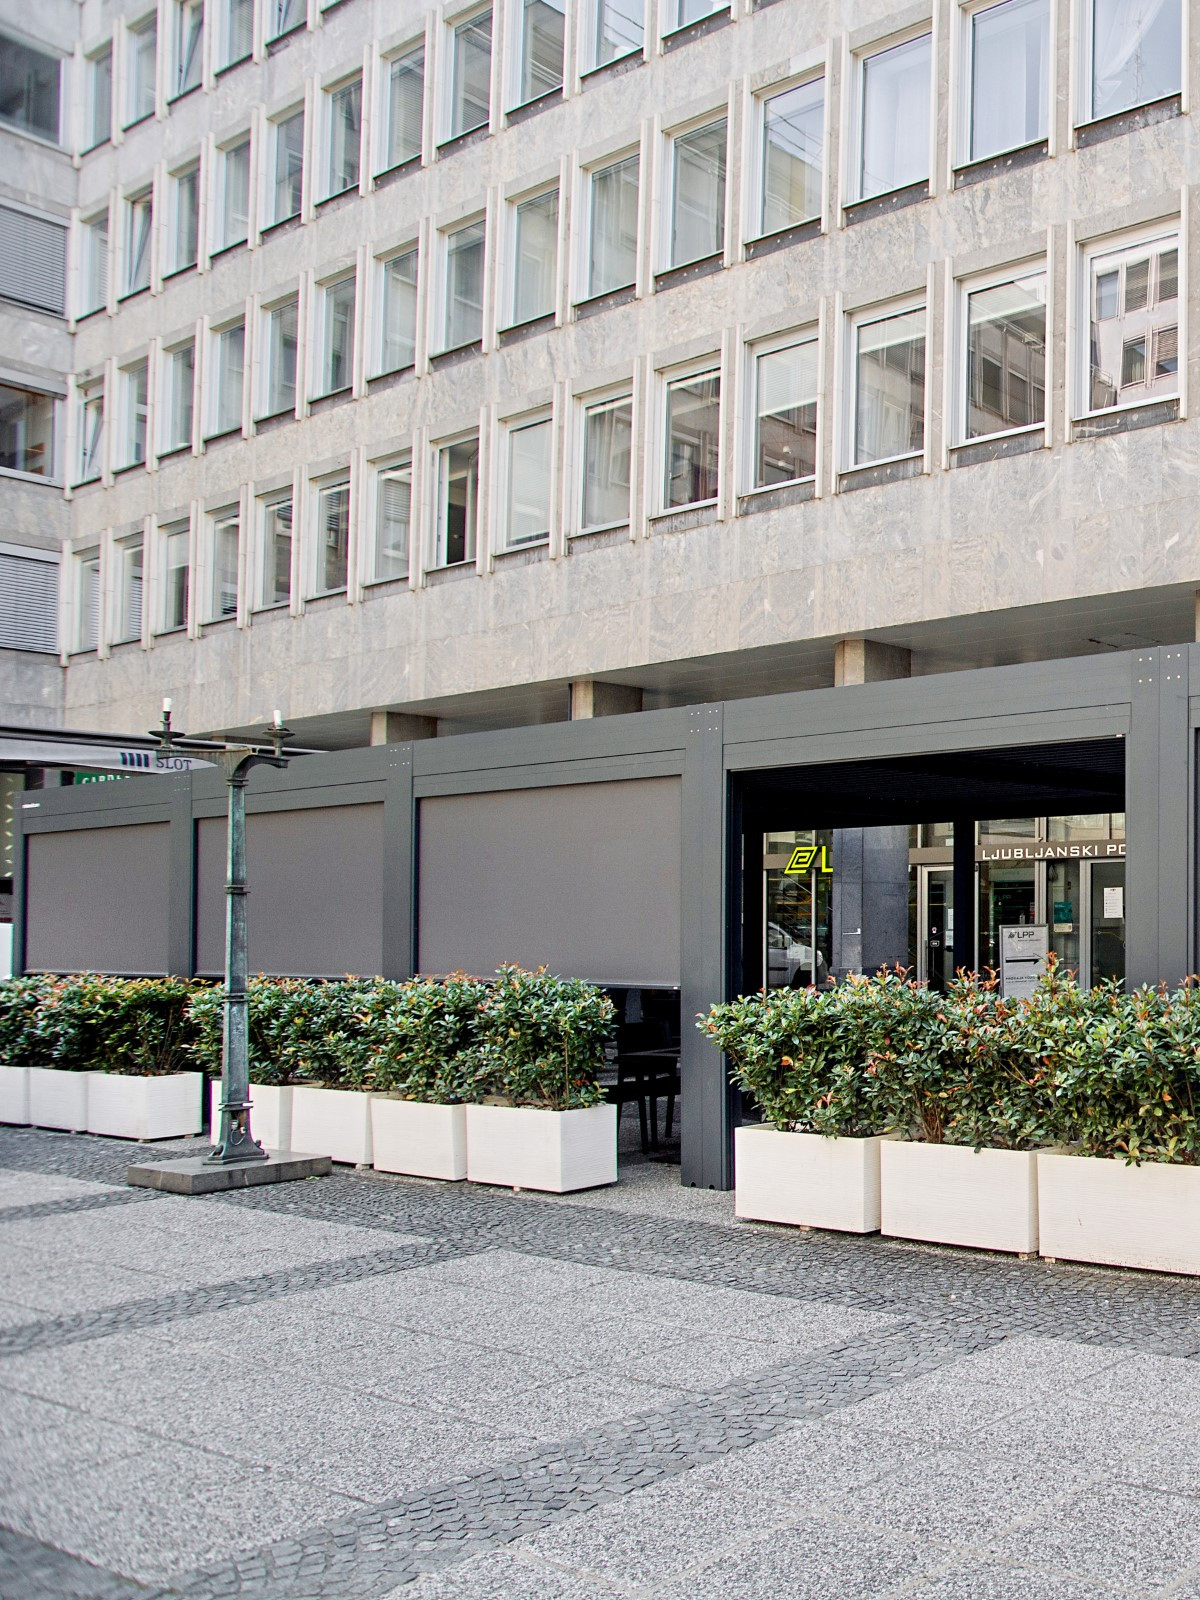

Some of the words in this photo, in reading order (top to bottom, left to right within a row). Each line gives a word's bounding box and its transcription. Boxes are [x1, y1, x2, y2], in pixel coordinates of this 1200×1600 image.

[156, 758, 192, 771] SLOT
[982, 845, 1098, 860] LJUBLJANSKI
[1017, 931, 1035, 939] LPP
